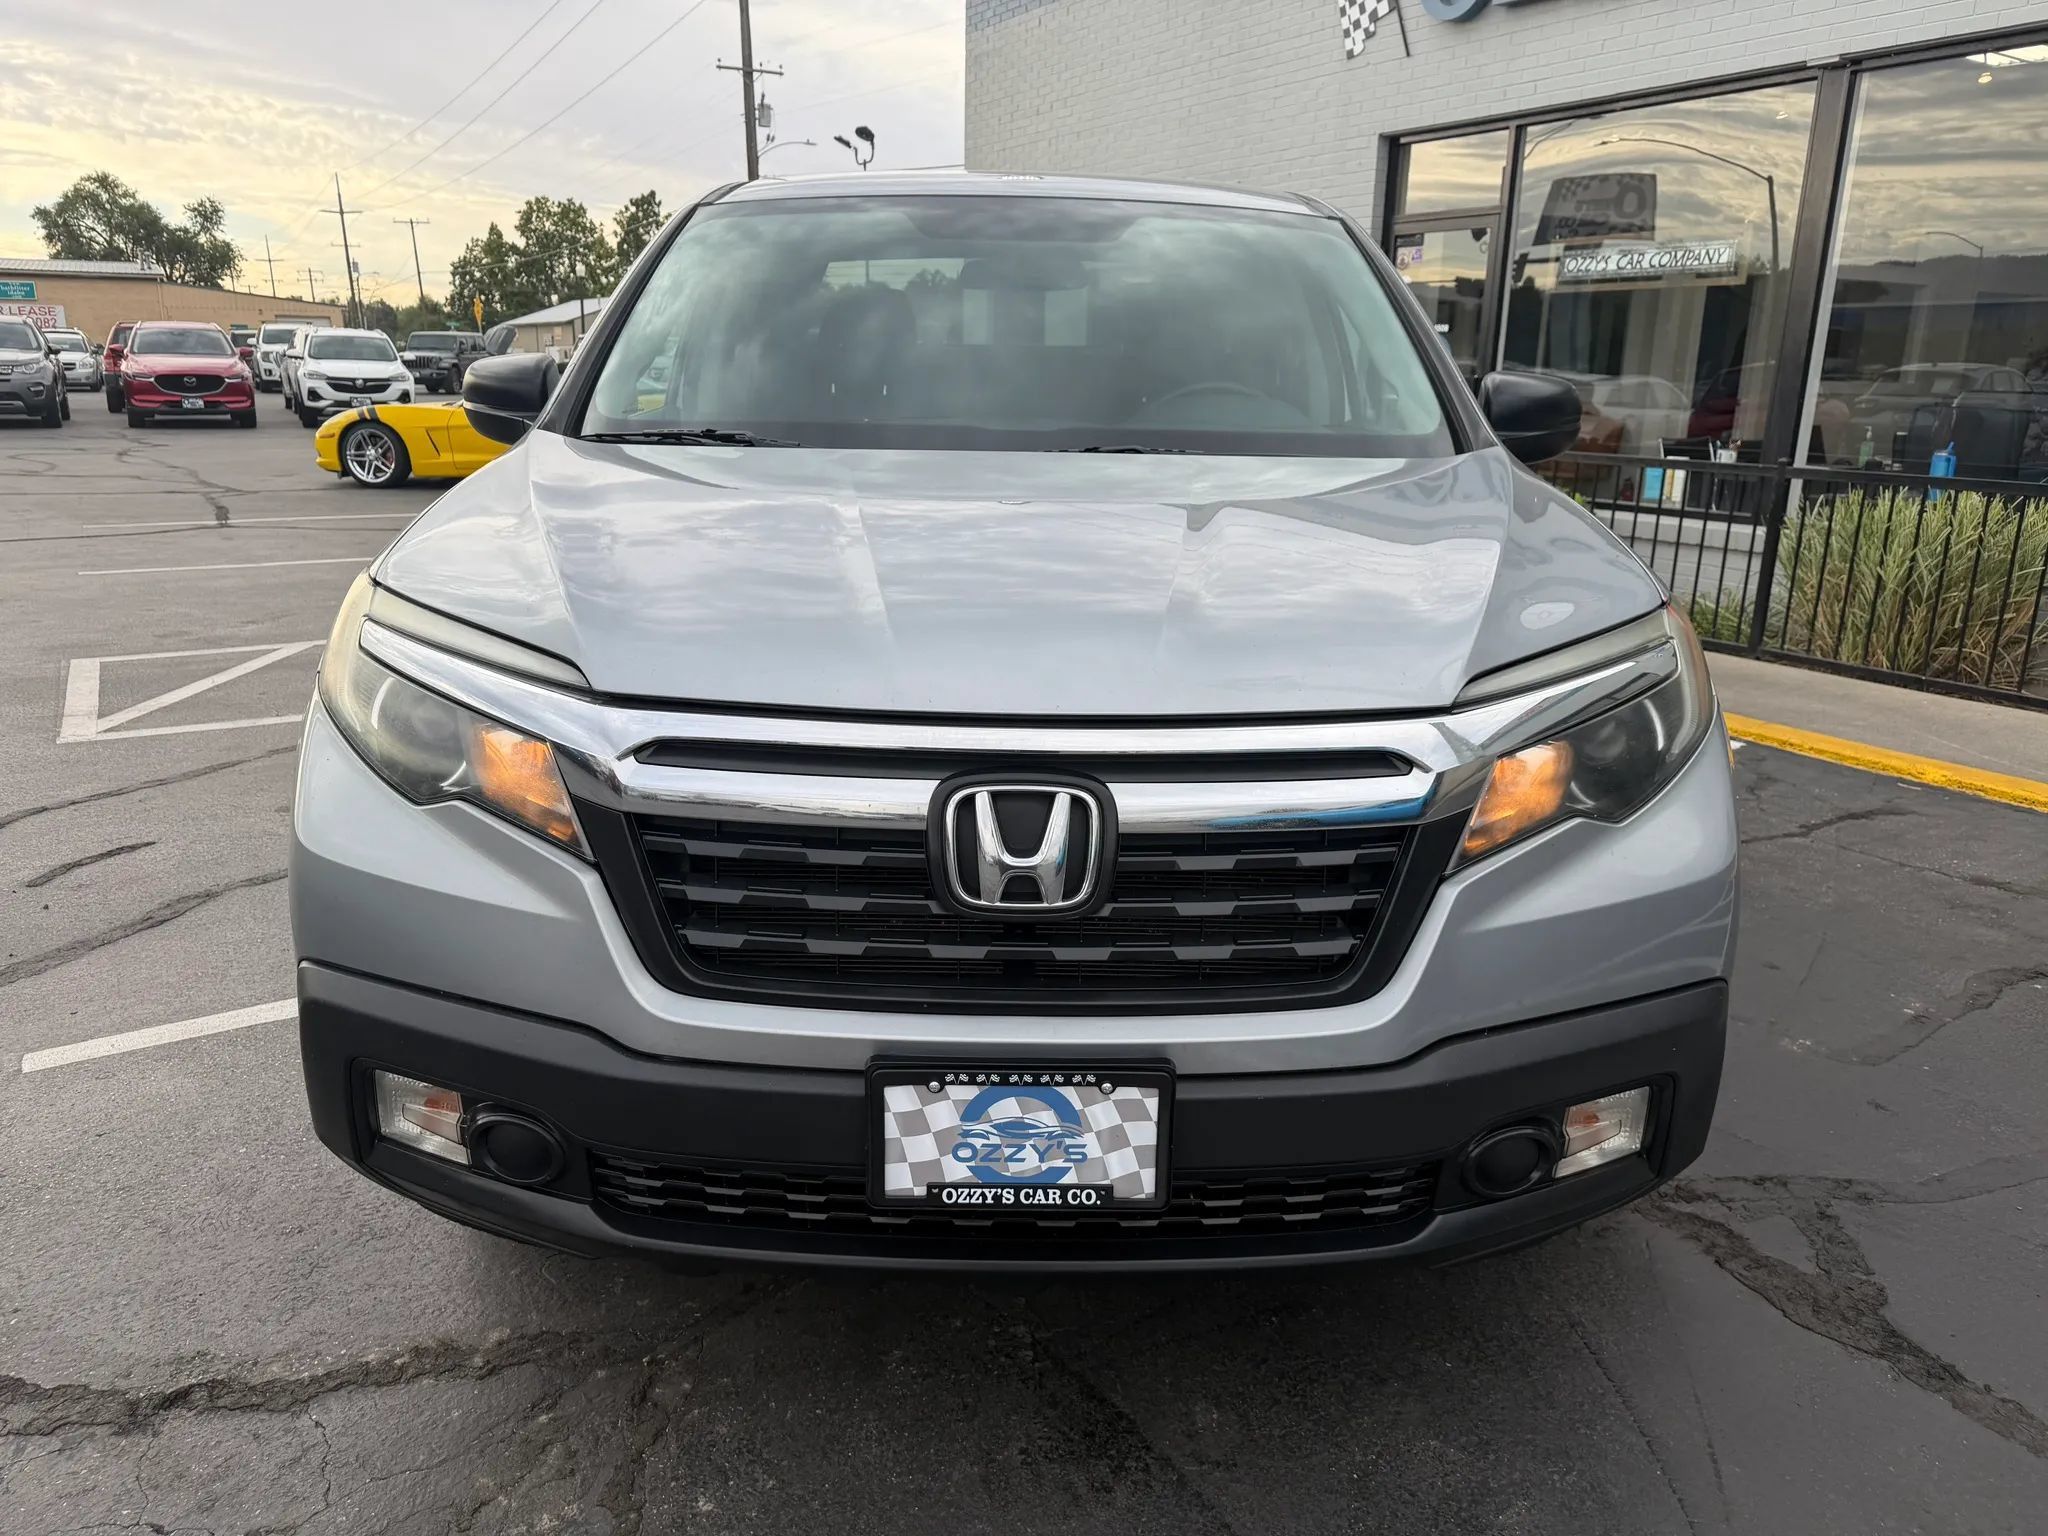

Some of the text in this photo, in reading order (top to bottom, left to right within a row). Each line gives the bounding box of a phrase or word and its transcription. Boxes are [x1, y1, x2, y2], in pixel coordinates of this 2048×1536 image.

[1566, 247, 1726, 274] OZZY'S CAR COMPANY
[9, 305, 57, 316] LEASE
[951, 1141, 1088, 1163] OZZY'S
[941, 1187, 1101, 1206] OZZY'S CAR CO.
